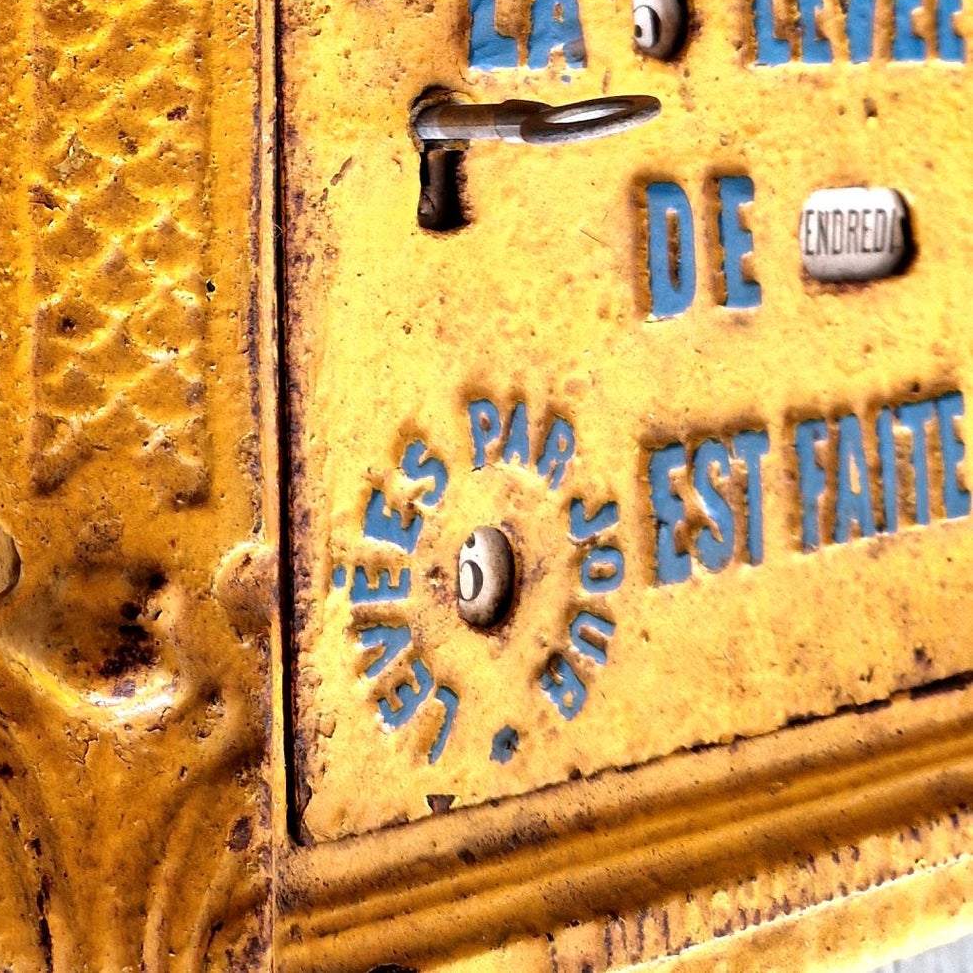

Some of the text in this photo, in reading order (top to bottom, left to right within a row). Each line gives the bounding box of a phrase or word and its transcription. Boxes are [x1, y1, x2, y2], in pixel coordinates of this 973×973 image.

[648, 178, 896, 315] DE ENDREDI
[468, 398, 576, 491] PAR
[540, 497, 625, 721] JOUR
[649, 390, 971, 584] EST FAITE
